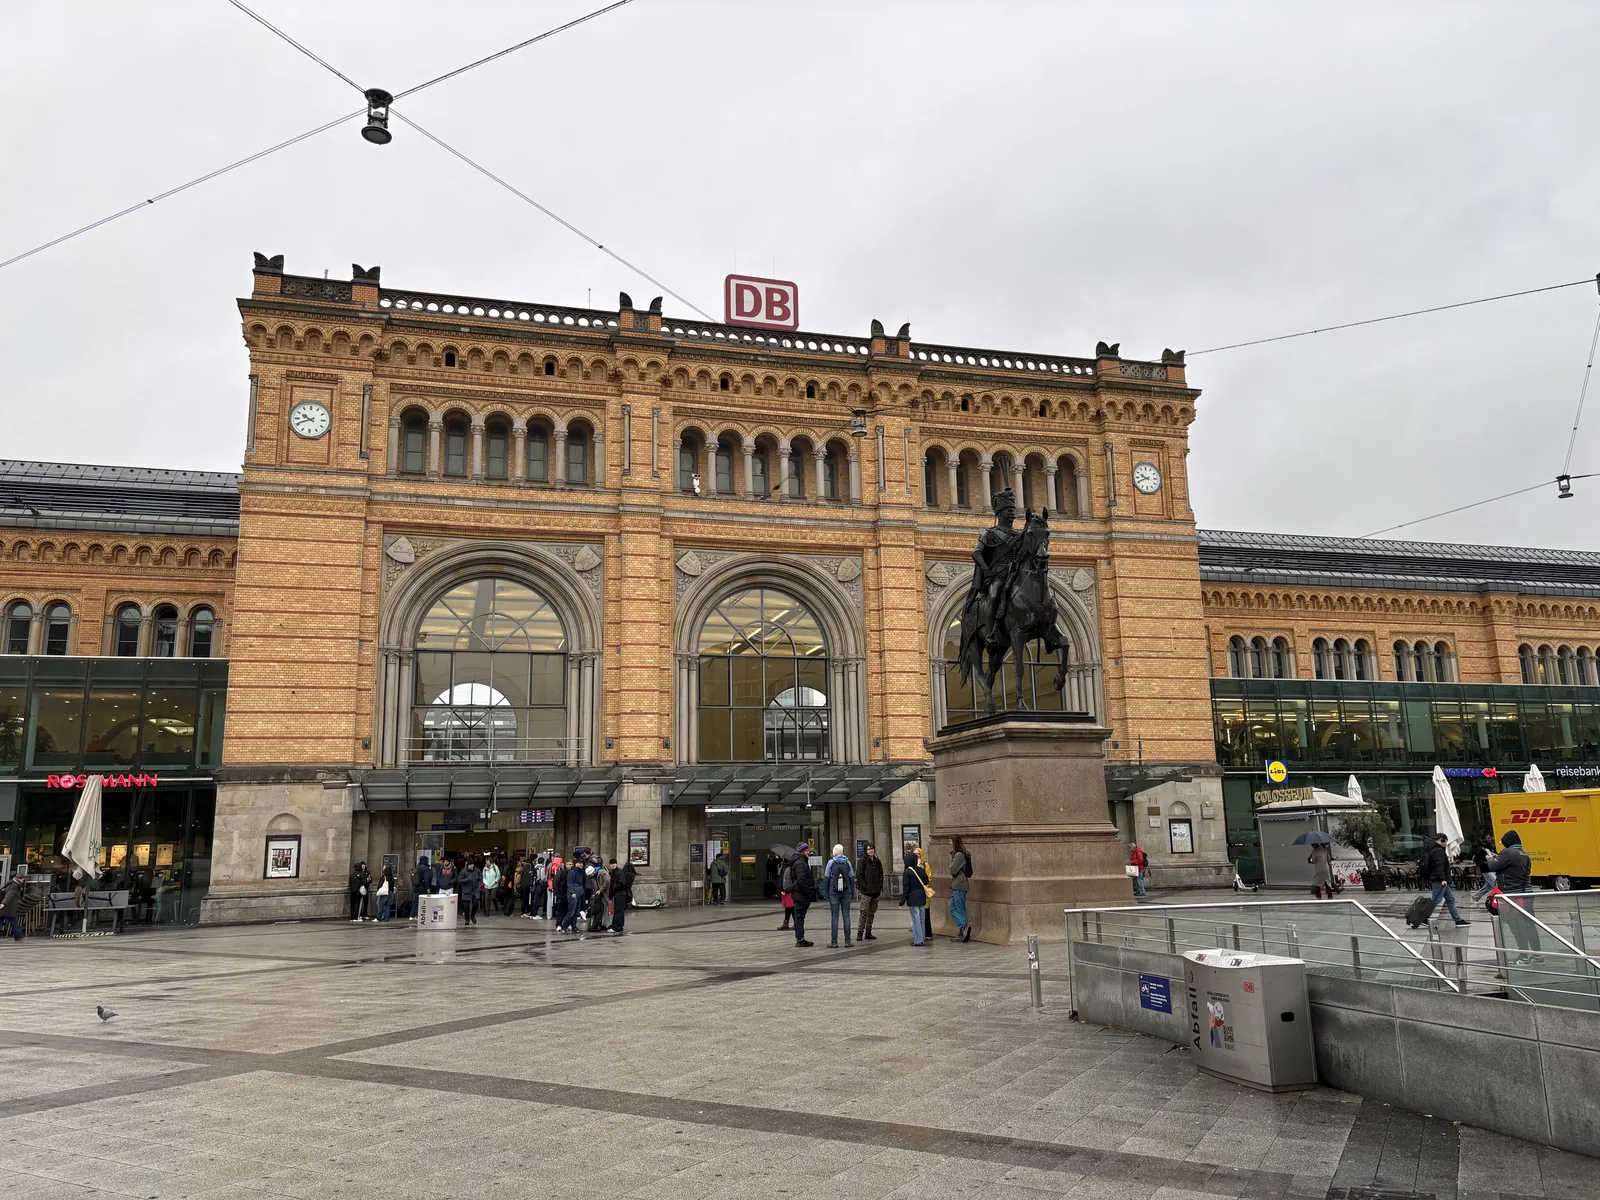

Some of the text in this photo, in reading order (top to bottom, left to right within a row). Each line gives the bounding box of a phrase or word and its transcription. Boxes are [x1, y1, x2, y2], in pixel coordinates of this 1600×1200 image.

[735, 282, 792, 322] DB
[47, 774, 157, 788] ROSMANN
[1253, 786, 1313, 804] COLOSSEUM
[1510, 807, 1567, 824] DHL
[1189, 987, 1202, 1051] Abfall
